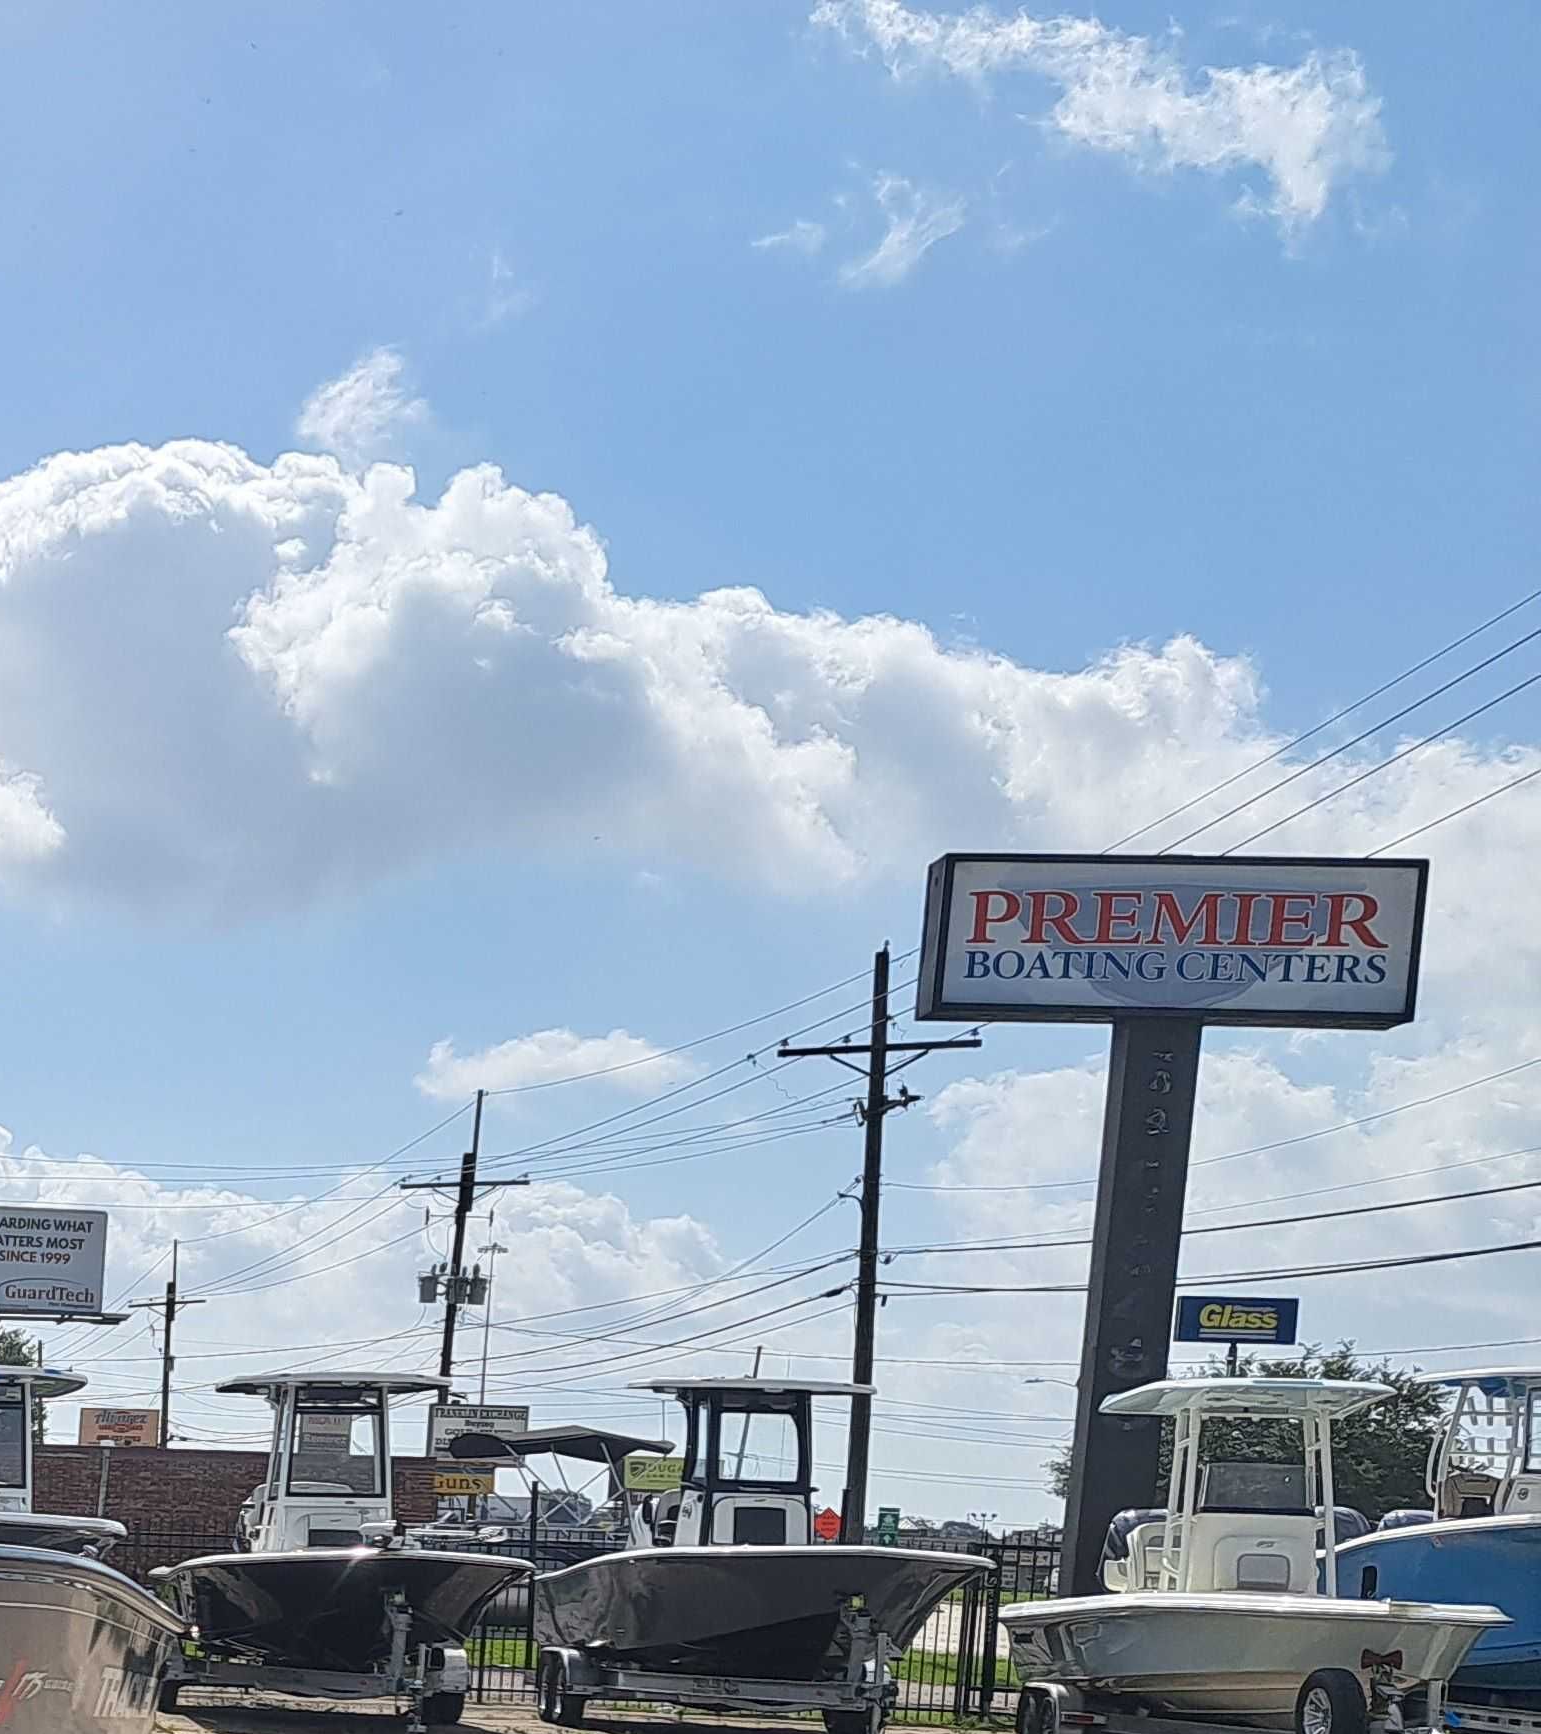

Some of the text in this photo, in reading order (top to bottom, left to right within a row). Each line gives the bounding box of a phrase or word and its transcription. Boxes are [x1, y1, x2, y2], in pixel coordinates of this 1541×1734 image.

[964, 889, 1390, 949] PREMIER
[964, 950, 1387, 985] BOATING CENTERS
[53, 1220, 94, 1233] WHAT
[45, 1237, 85, 1250] MOST
[40, 1251, 71, 1265] 1999
[5, 1284, 94, 1303] GuardTech
[1199, 1303, 1279, 1329] Glass
